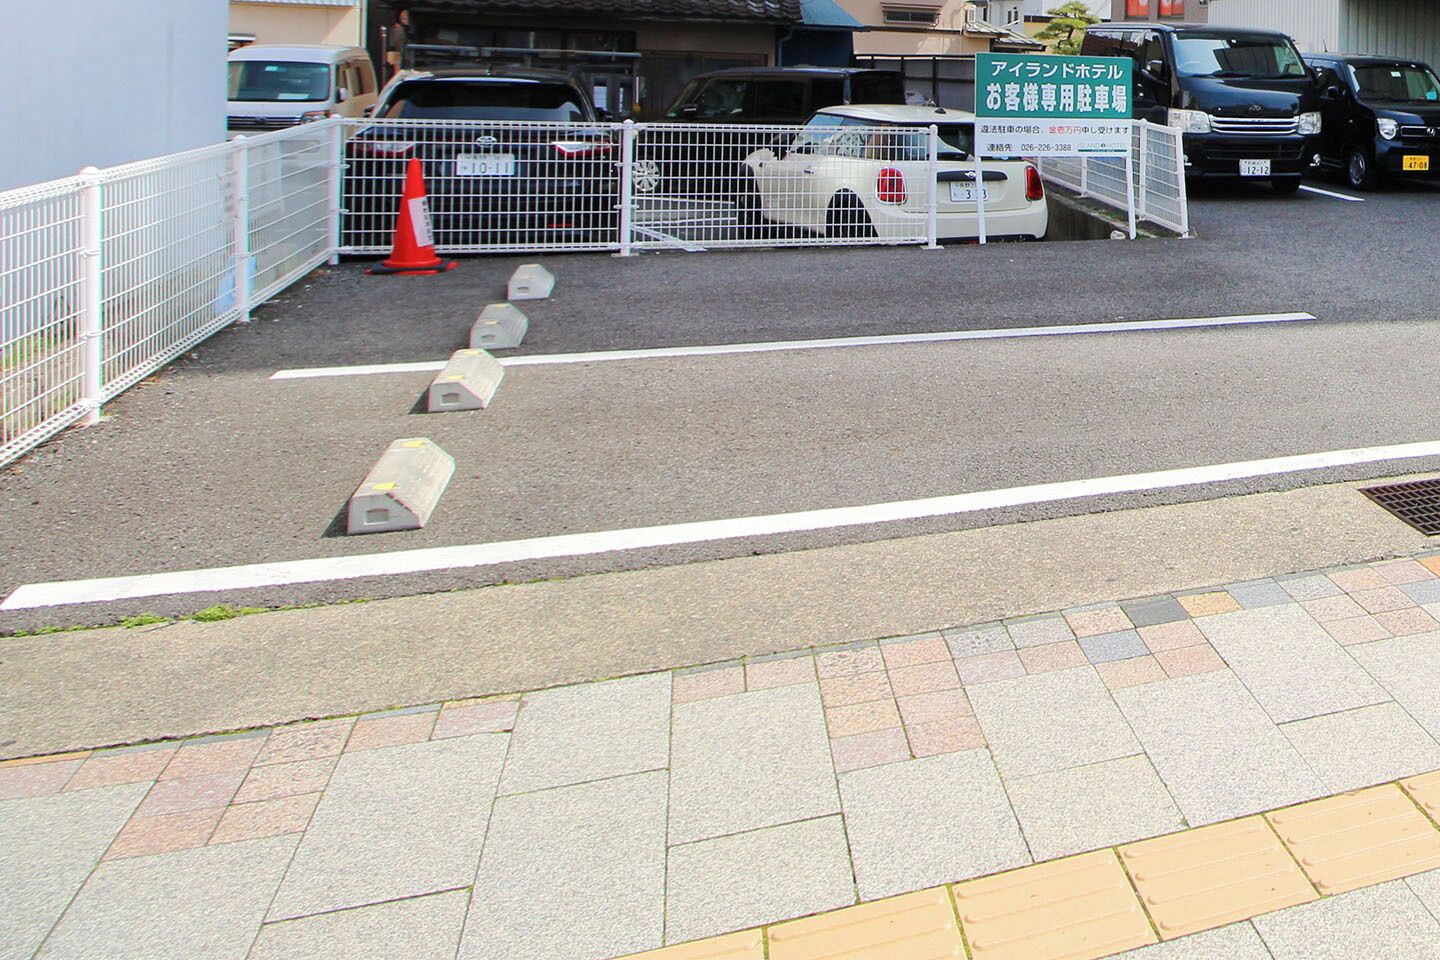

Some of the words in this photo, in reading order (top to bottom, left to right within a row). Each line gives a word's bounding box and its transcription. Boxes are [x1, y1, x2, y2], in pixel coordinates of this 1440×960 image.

[991, 61, 1124, 80] アイランドホテル
[986, 82, 1127, 113] お客様専用駐車場
[1247, 166, 1269, 175] 12-12
